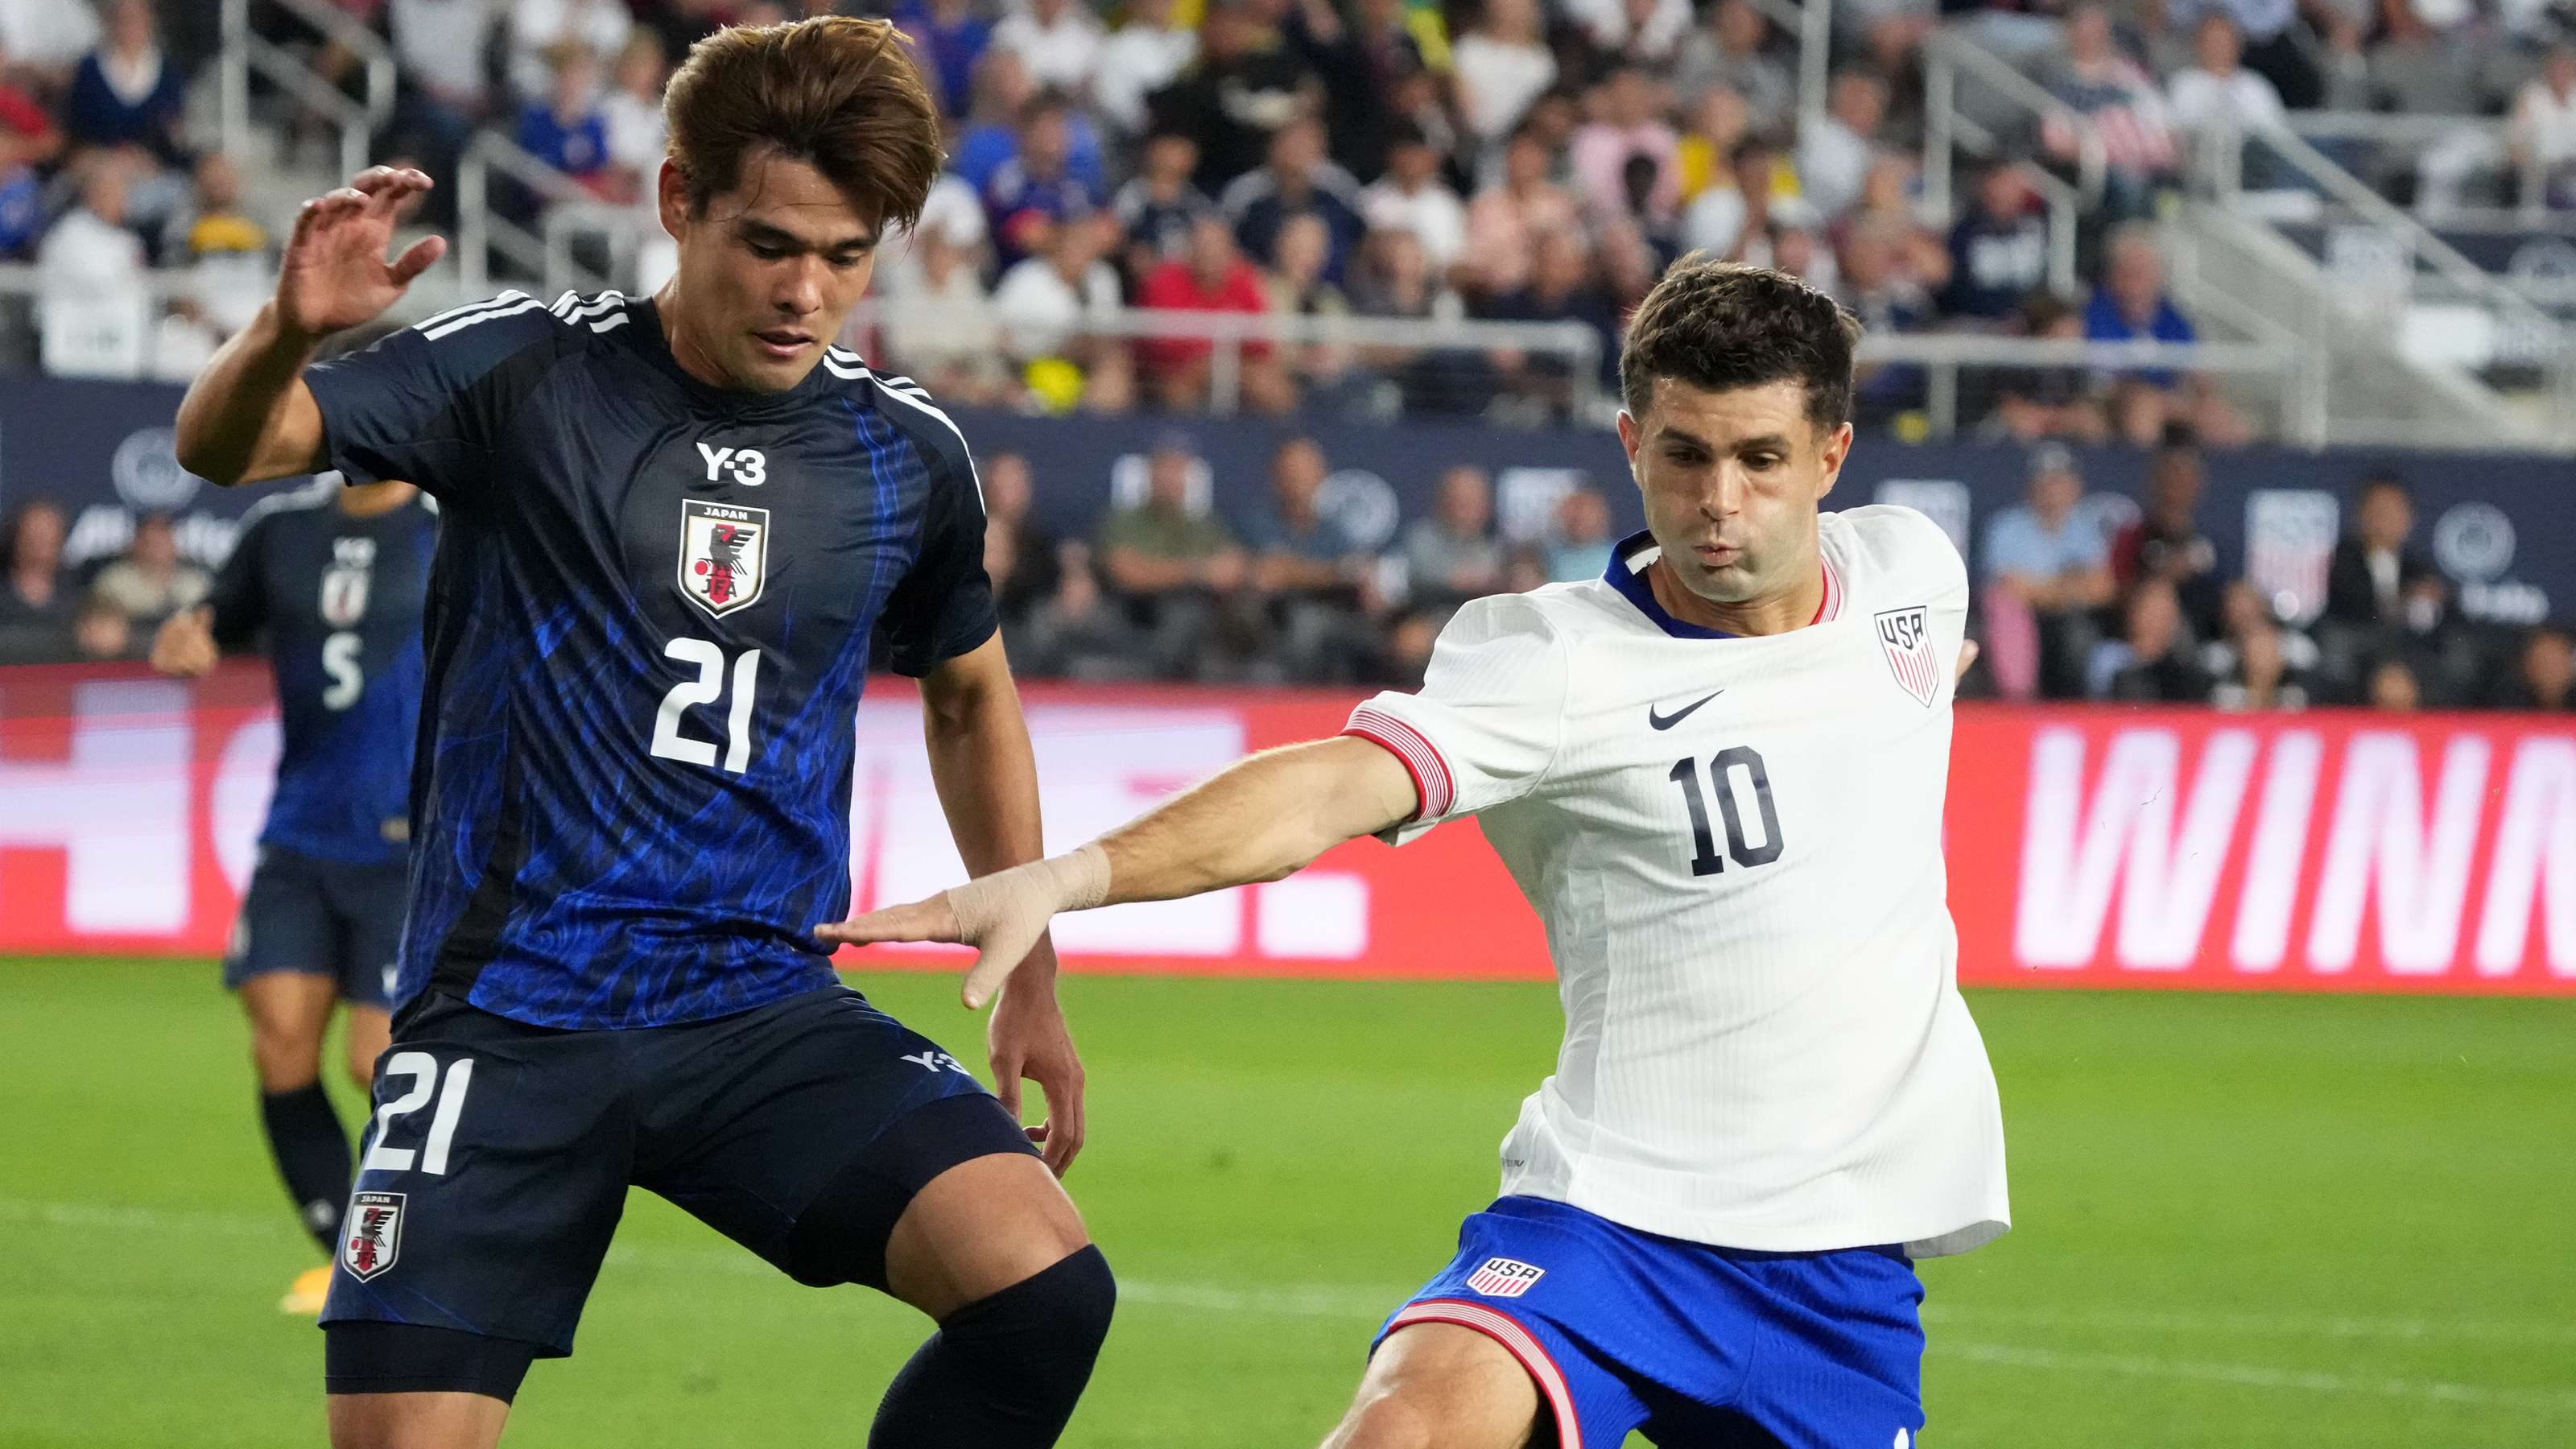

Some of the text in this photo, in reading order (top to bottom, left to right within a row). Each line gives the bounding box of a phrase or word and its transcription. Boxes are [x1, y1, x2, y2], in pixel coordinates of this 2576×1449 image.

[696, 442, 766, 486] Y-3
[704, 507, 748, 521] JAPAN
[700, 578, 737, 597] JFA
[1880, 613, 1923, 650] USA
[650, 637, 760, 774] 21
[1670, 745, 1785, 877] 10
[900, 1051, 971, 1076] Y-3
[364, 1051, 474, 1175] 21
[361, 1195, 391, 1203] JAPAN
[1487, 1260, 1539, 1279] USA
